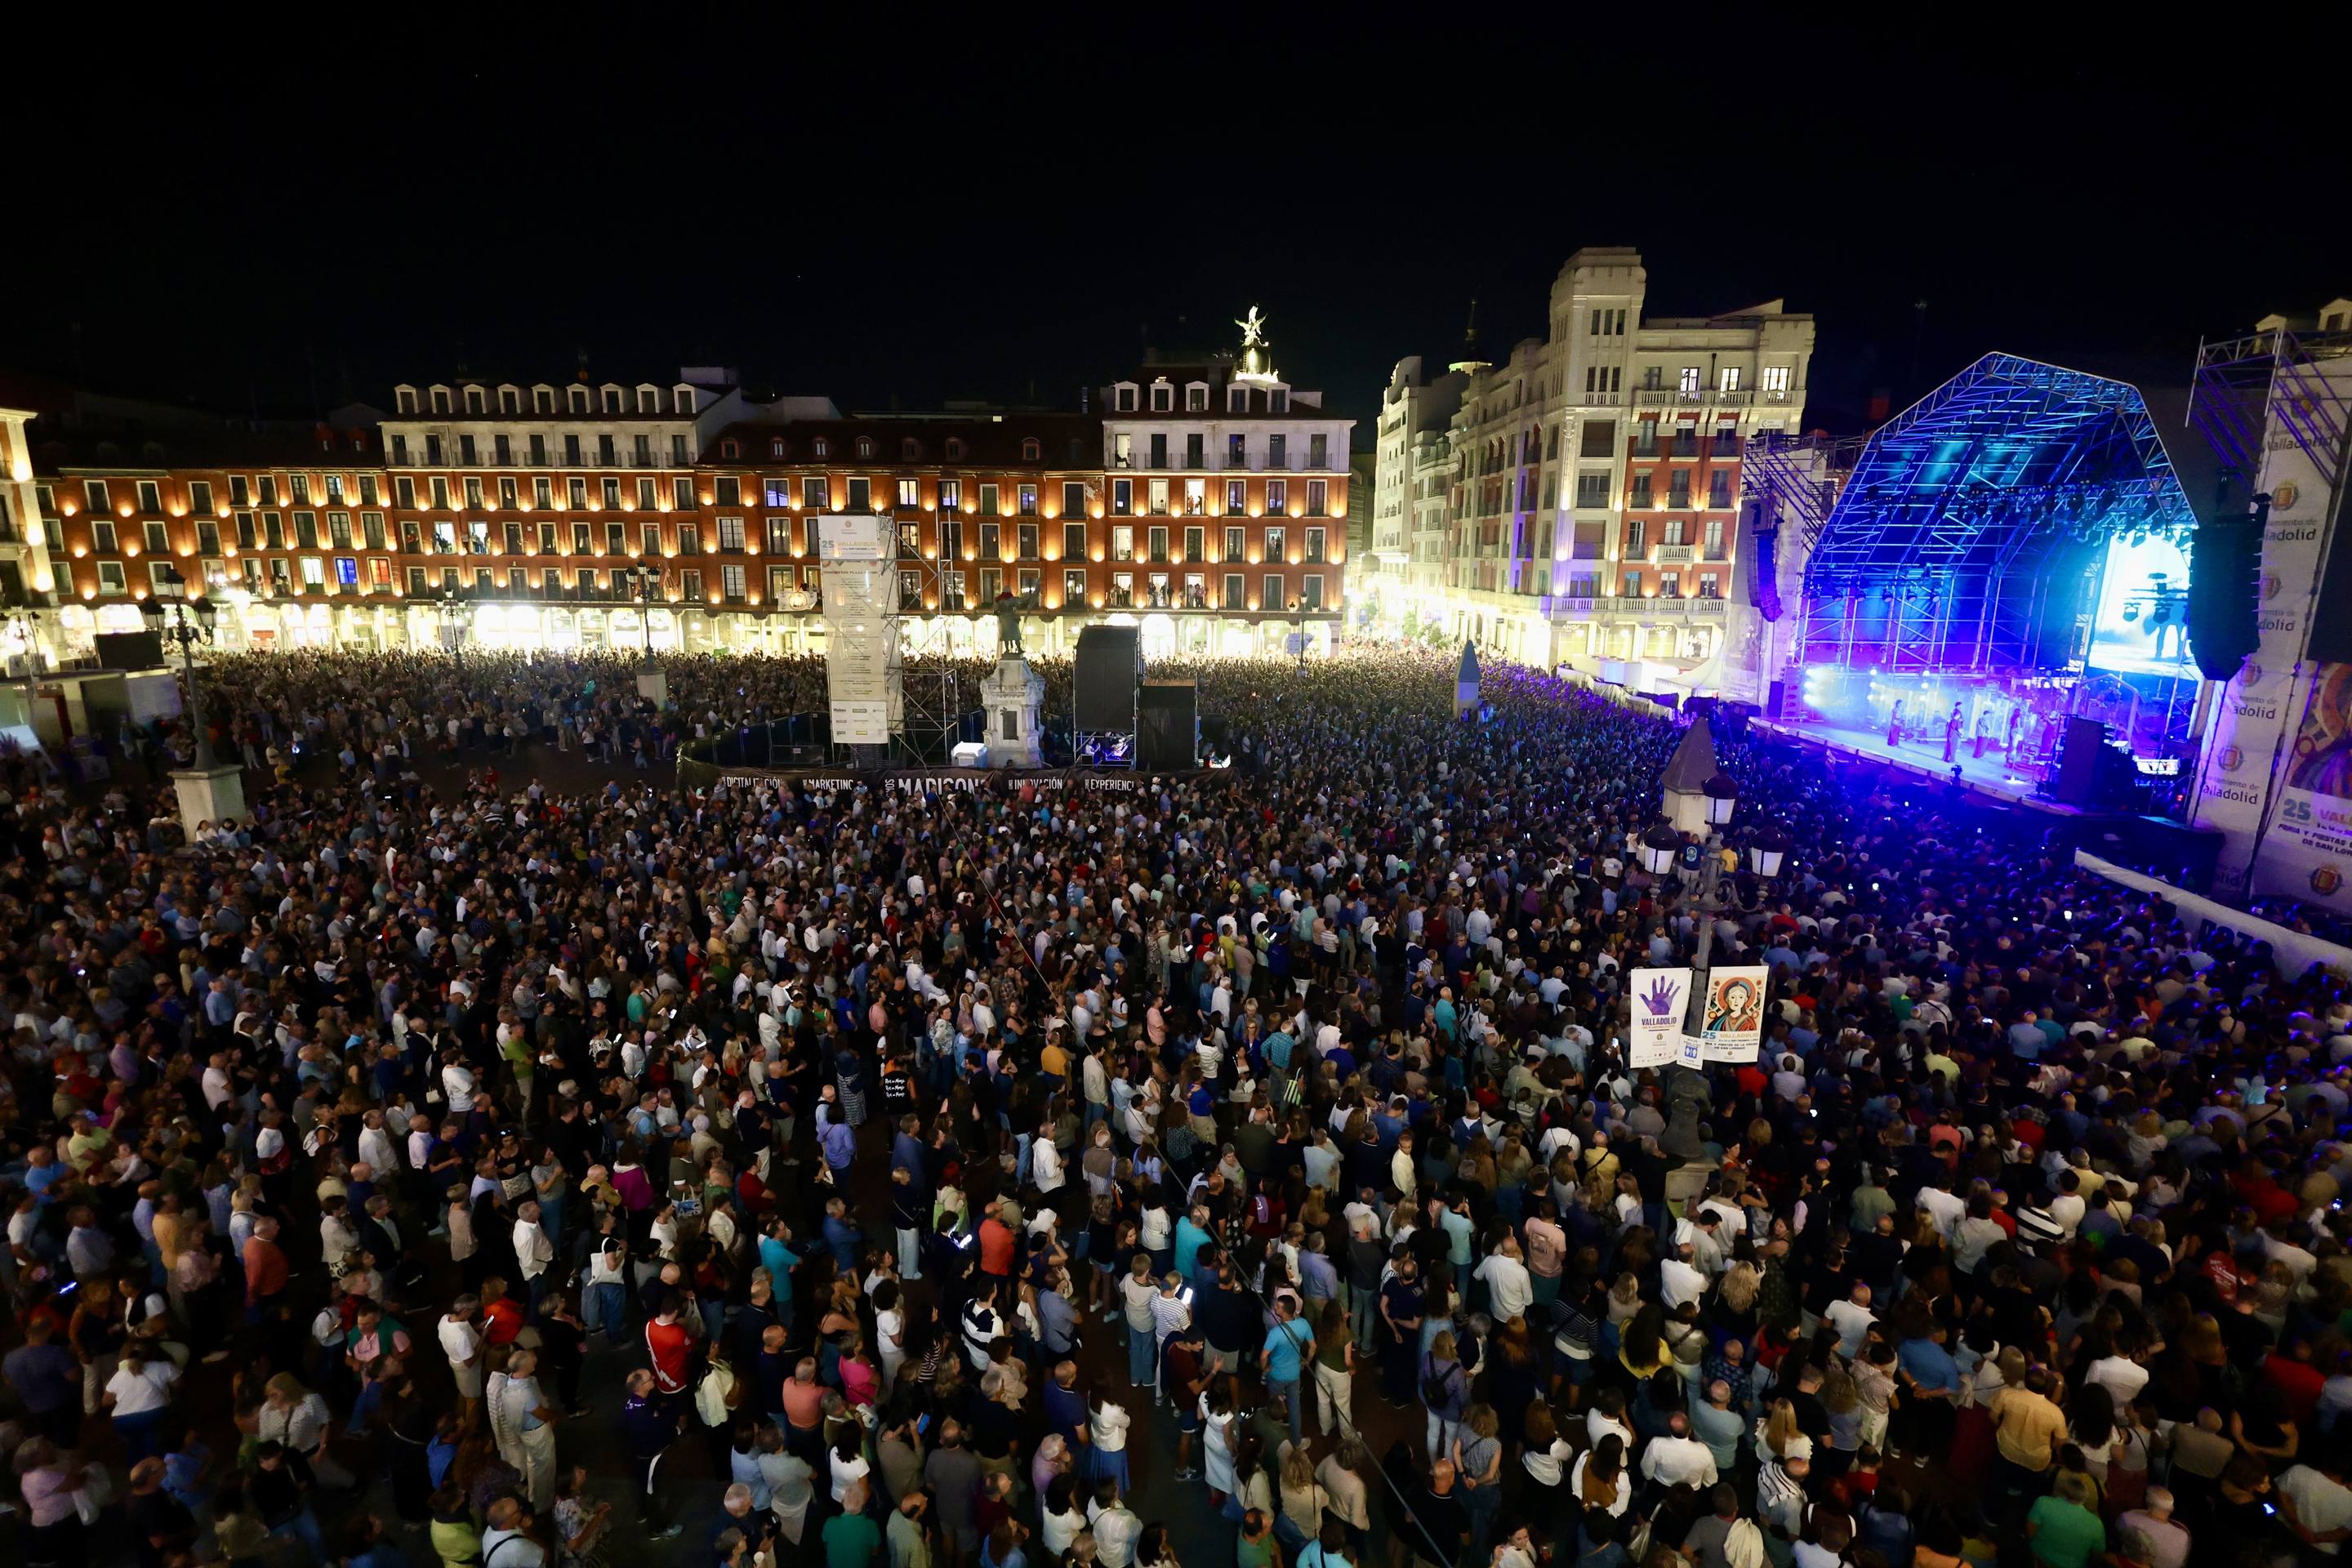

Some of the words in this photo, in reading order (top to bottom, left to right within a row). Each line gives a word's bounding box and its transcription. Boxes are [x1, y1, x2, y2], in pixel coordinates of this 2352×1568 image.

[2265, 528, 2317, 541] ladolid
[822, 540, 835, 549] 25
[2256, 617, 2296, 631] dolid
[2232, 704, 2277, 719] adolid
[2201, 784, 2259, 805] alladolid
[2283, 798, 2312, 821] 25
[2335, 847, 2352, 857] LOR
[1701, 1031, 1716, 1040] 25
